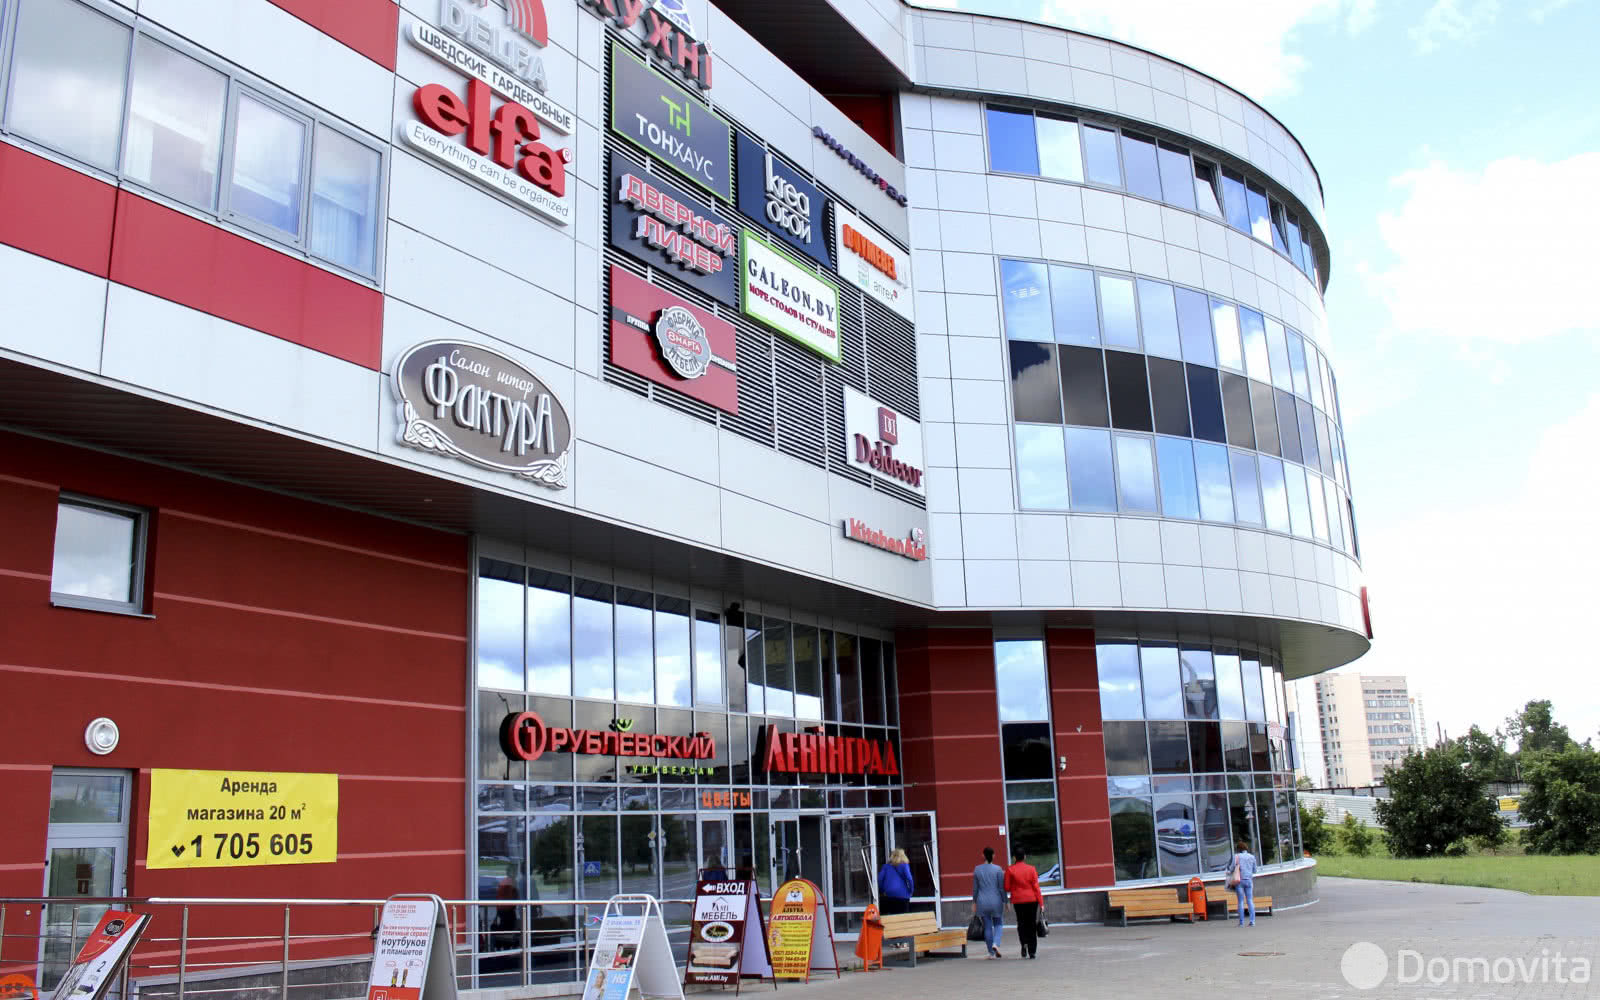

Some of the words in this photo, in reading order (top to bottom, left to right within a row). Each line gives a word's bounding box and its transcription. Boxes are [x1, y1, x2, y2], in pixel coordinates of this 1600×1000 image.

[419, 26, 487, 79] ШВЕДСКИЕ
[492, 72, 572, 130] ГАРДЕРОБНЫЕ
[413, 79, 565, 198] elfa
[636, 113, 713, 181] ТОНХАУС
[413, 125, 477, 170] Everything
[480, 163, 500, 181] can
[502, 174, 517, 189] be
[519, 184, 569, 217] organized
[765, 153, 810, 217] krea
[620, 174, 735, 257] ДВЕРНОЙ
[637, 215, 722, 274] ЛИДЕР
[748, 258, 834, 322] GALEON.BY
[748, 282, 769, 302] МОРЕ
[769, 296, 799, 319] СТОЛОВ
[799, 313, 805, 323] И
[805, 317, 836, 339] СТУЛЬЕВ
[450, 349, 491, 378] Салон
[497, 371, 534, 400] штор
[846, 517, 926, 561] KitchenAid
[220, 777, 277, 796] Аренда
[633, 764, 714, 776] УНИВЕРСАМ
[187, 808, 264, 821] магазина
[269, 805, 286, 820] 20
[702, 792, 751, 808] ЦВЕТЫ
[190, 834, 203, 858] 1
[213, 832, 260, 860] 705
[269, 833, 313, 856] 605
[716, 882, 745, 895] ВХОД
[701, 911, 738, 920] МЕБЕЛЬ
[381, 937, 427, 948] ноутбуков
